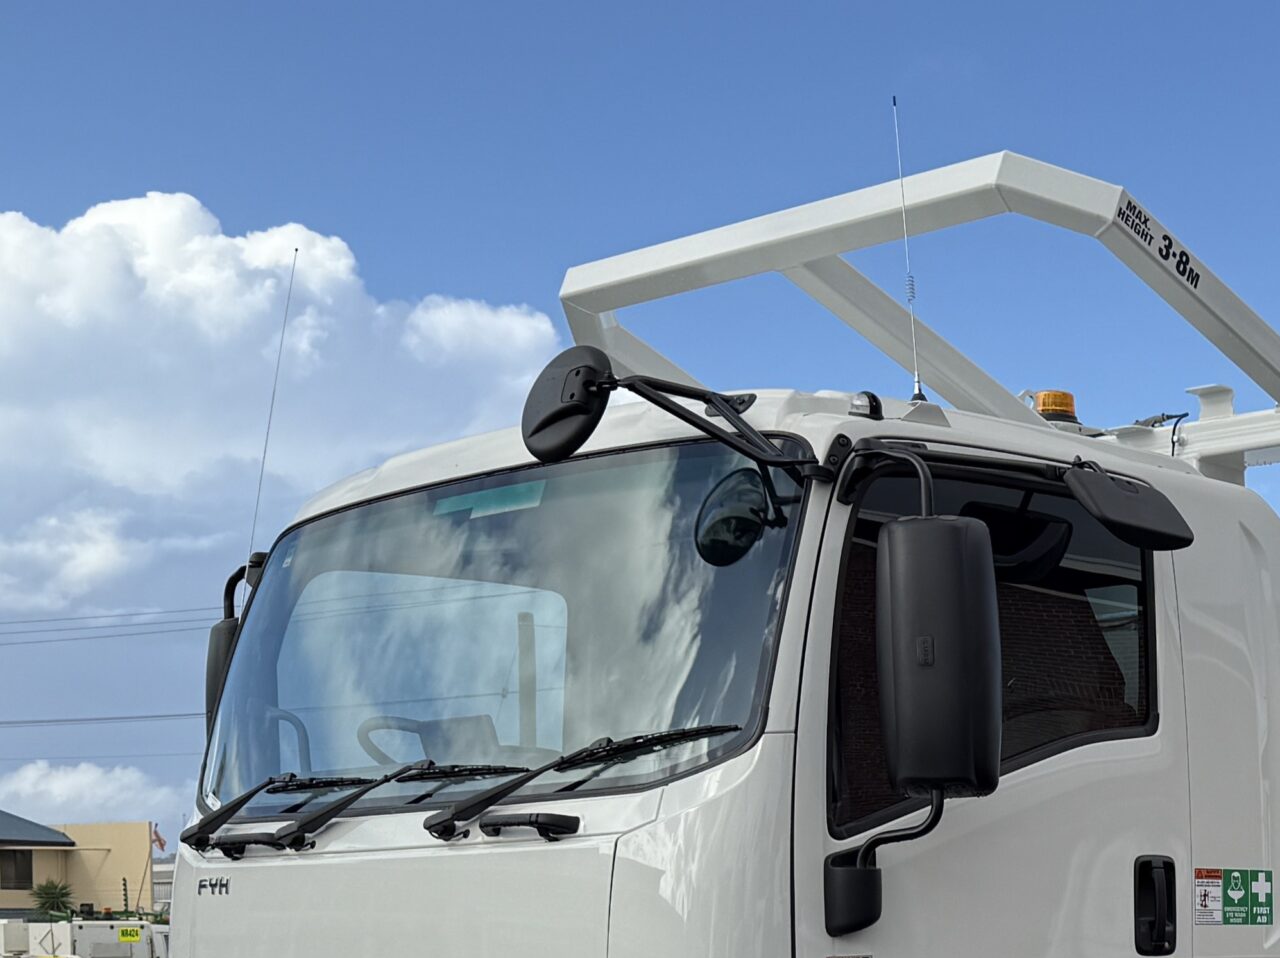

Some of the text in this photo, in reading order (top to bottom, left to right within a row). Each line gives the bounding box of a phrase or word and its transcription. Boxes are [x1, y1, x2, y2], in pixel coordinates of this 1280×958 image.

[1117, 207, 1154, 246] HEIGHT
[1126, 200, 1150, 231] MAX.
[198, 877, 231, 895] FYH
